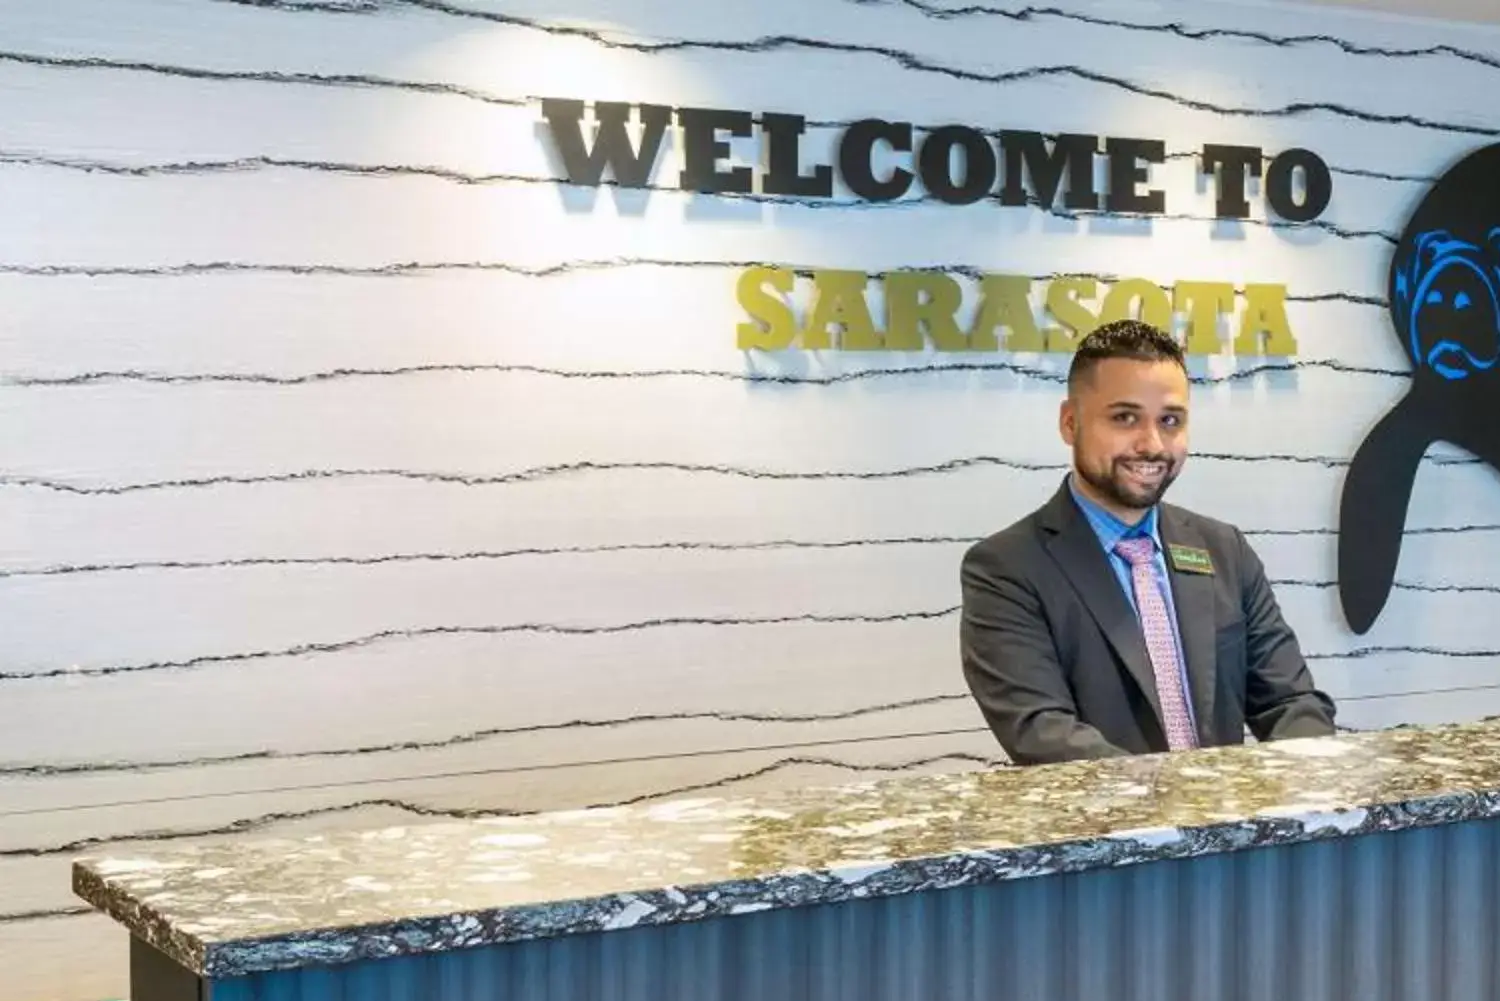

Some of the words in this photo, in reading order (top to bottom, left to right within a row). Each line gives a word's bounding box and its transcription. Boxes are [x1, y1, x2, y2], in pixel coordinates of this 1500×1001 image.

[541, 97, 1166, 214] WELCOME
[1202, 144, 1333, 222] TO
[735, 266, 1297, 355] SARASOTA
